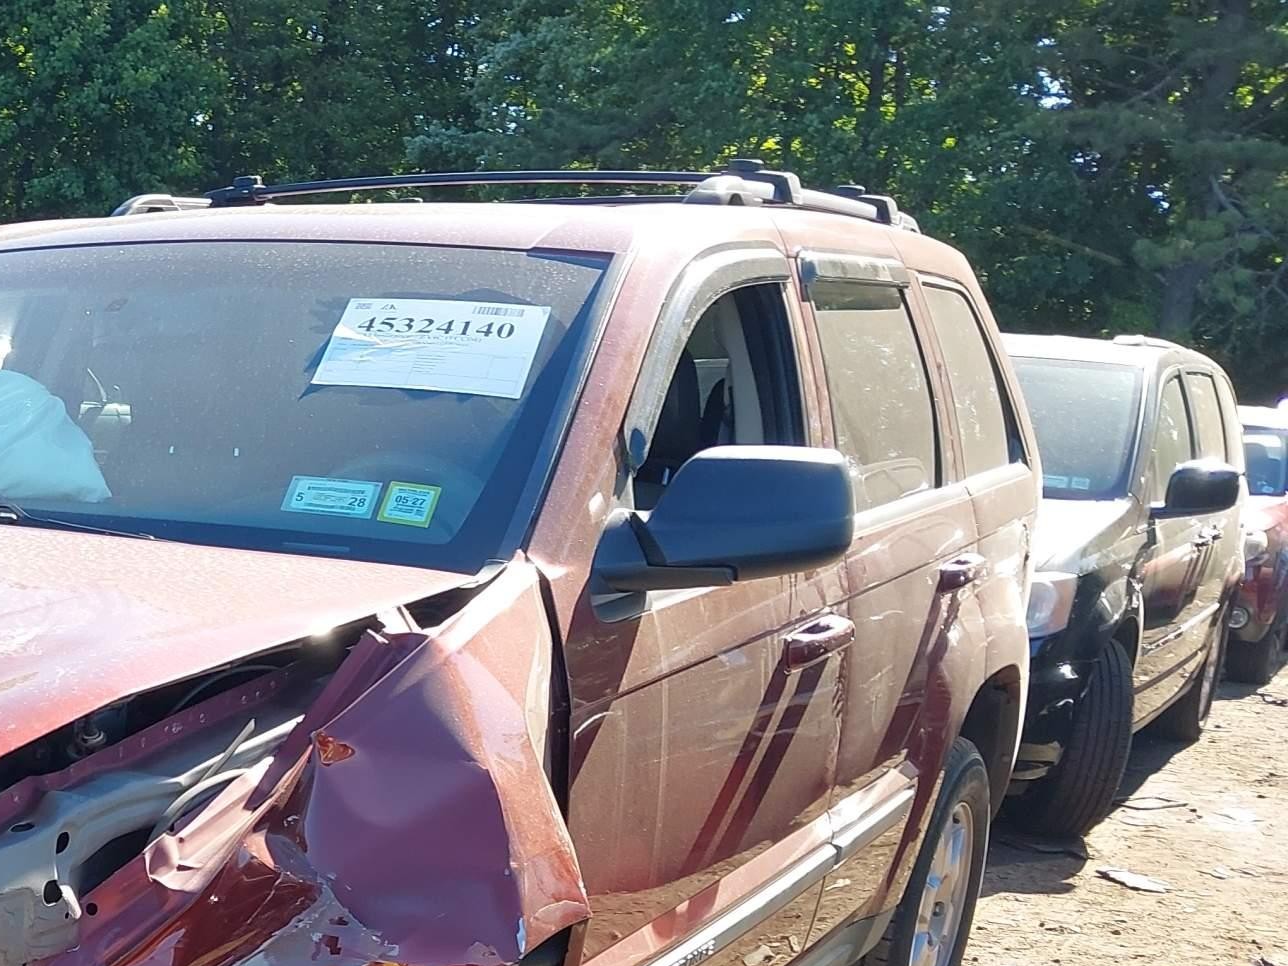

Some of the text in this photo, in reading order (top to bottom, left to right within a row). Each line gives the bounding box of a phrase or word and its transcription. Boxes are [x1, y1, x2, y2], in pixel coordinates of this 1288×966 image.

[357, 316, 516, 340] 45324140
[295, 491, 305, 502] 5
[347, 496, 367, 508] 28
